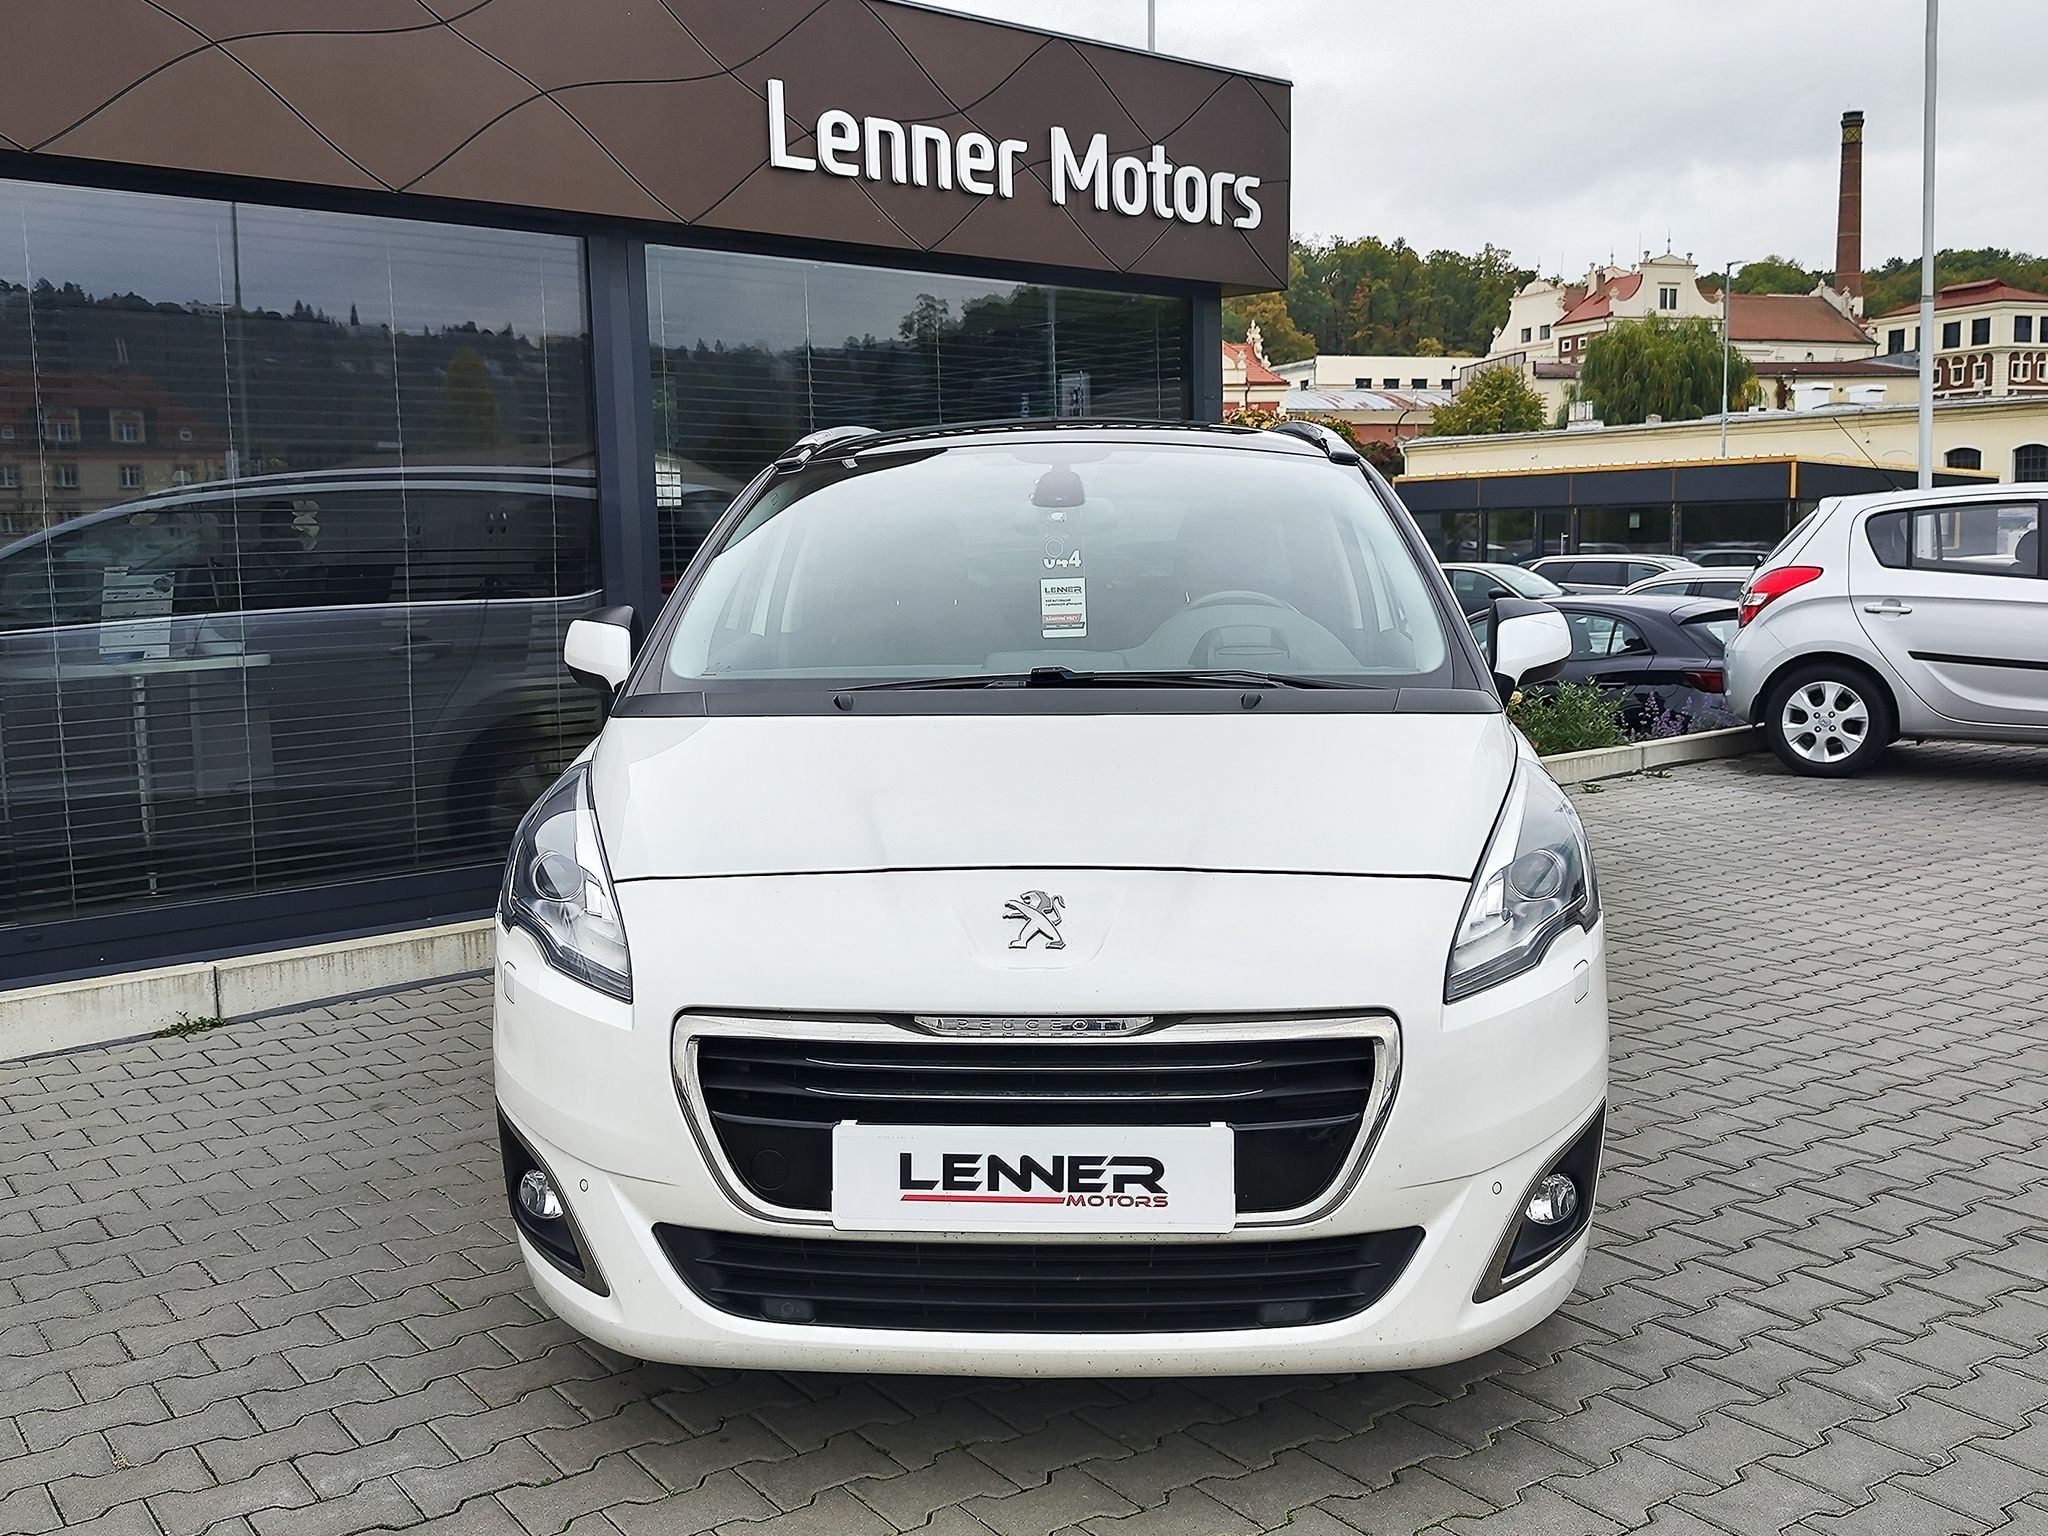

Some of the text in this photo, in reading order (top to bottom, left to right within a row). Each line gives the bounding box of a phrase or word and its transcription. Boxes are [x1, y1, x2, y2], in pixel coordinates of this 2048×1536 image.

[766, 78, 1263, 230] Lenner Motors
[1044, 586, 1082, 594] LENNER
[955, 1019, 1112, 1031] PEUGEOT
[899, 1152, 1168, 1194] LENNER
[1066, 1195, 1168, 1208] MOTORS
